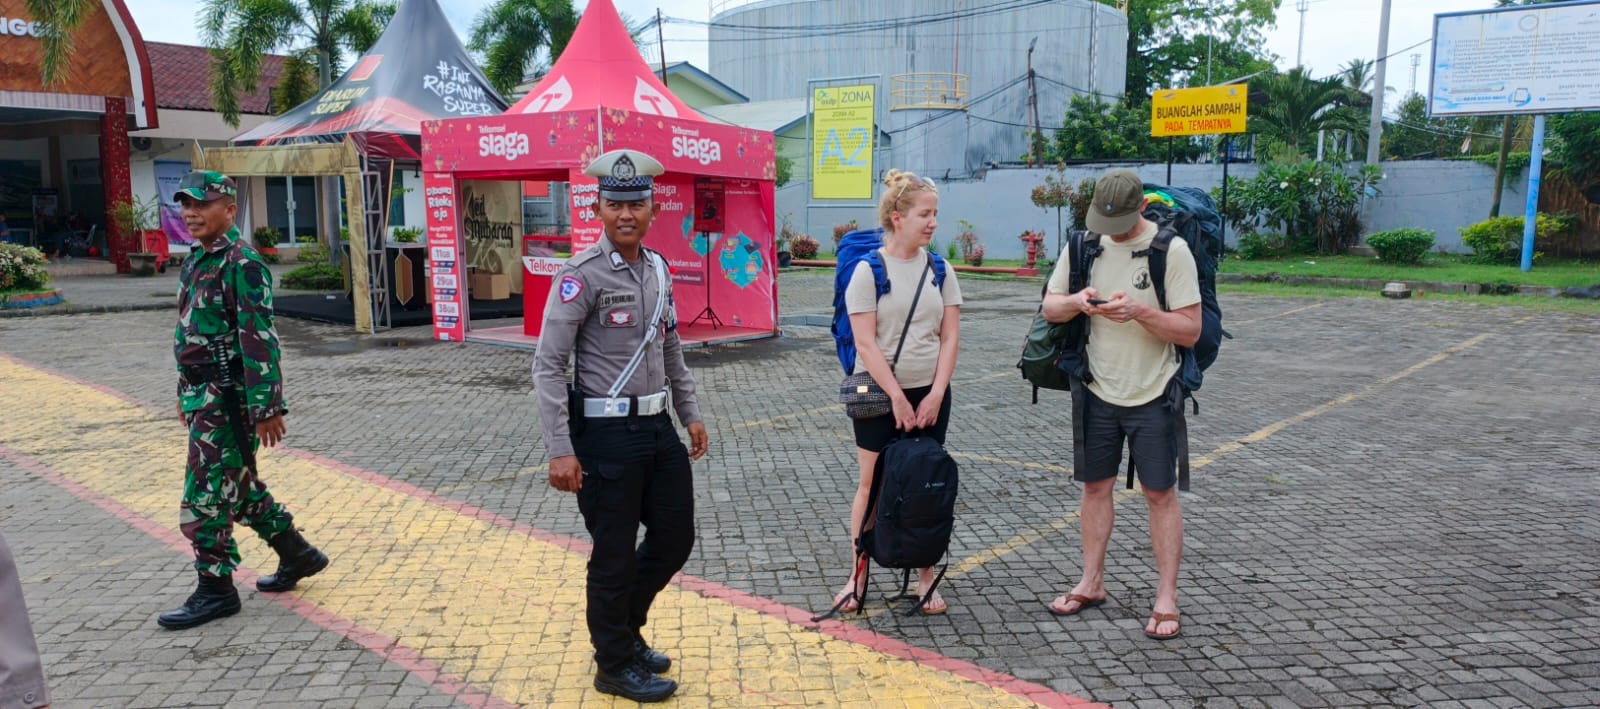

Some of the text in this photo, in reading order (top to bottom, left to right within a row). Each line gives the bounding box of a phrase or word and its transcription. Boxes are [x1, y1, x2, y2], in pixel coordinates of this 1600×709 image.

[436, 60, 471, 84] #INI
[423, 75, 487, 101] RASANYA
[841, 90, 872, 104] ZONA
[311, 100, 351, 115] SUPER
[443, 96, 493, 115] SUPER
[1156, 102, 1242, 119] BUANGLAH SAMPAH
[1164, 118, 1232, 132] PADA TEMPATNYA
[818, 126, 870, 168] A2
[652, 183, 677, 197] Siaga
[656, 200, 683, 211] adan
[433, 208, 448, 221] aja
[579, 207, 595, 222] aja
